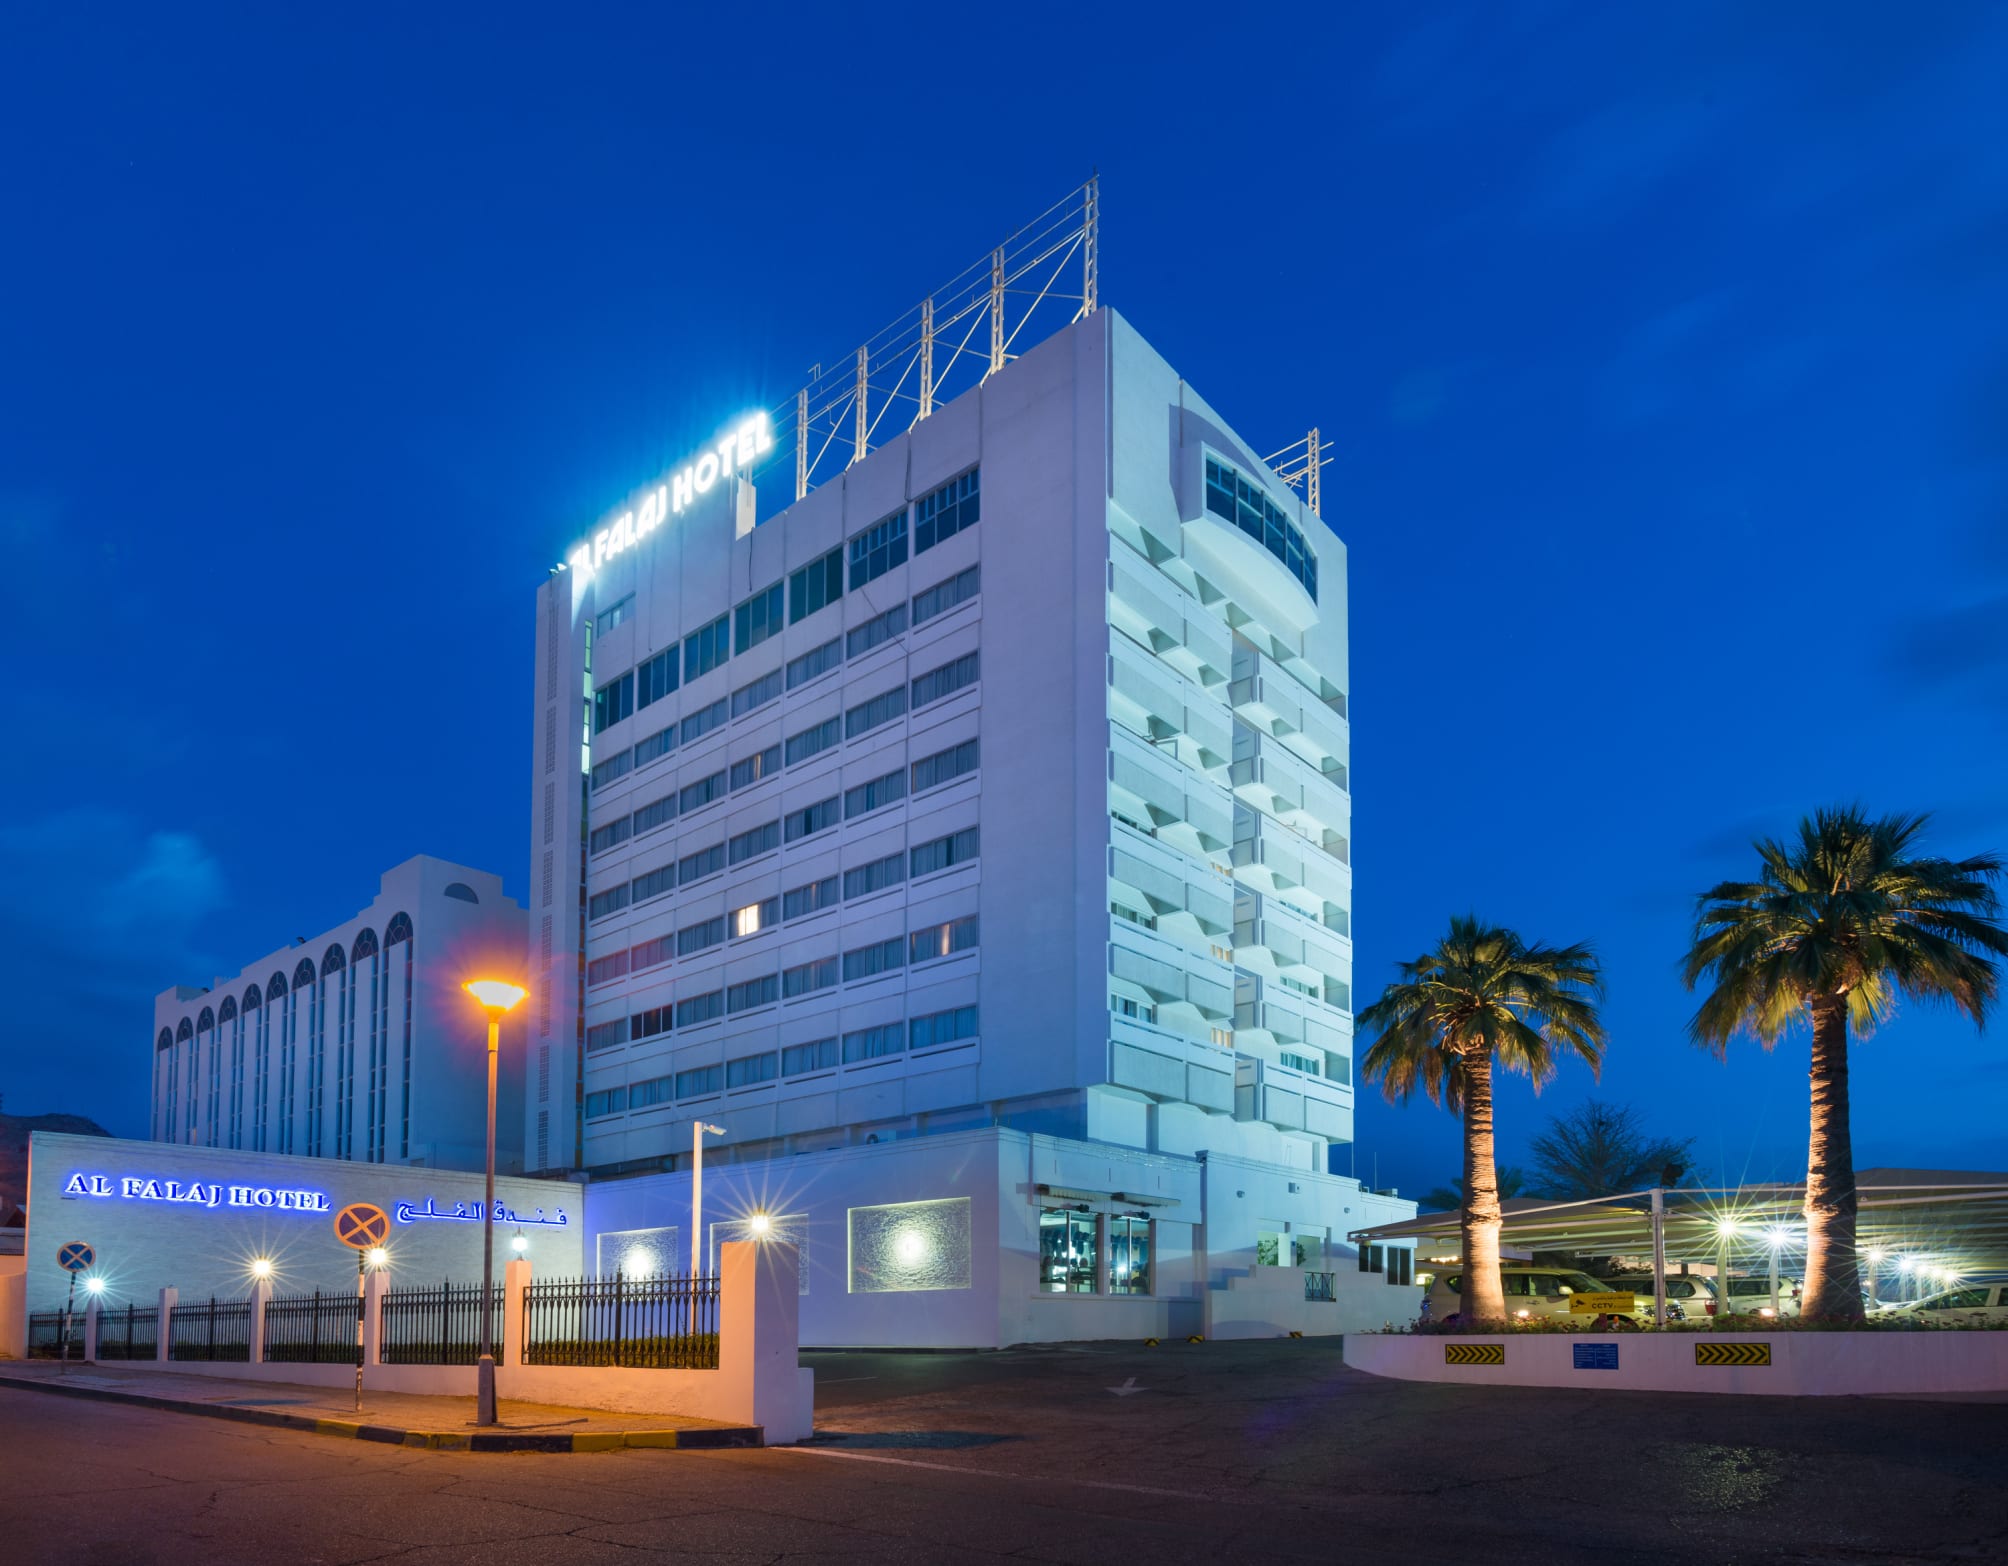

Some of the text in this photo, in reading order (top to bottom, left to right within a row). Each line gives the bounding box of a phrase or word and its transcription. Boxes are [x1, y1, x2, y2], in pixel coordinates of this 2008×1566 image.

[593, 485, 667, 568] FALAJ
[672, 411, 772, 513] HOTEL
[65, 1173, 332, 1212] AL FALAJ HOTEL
[397, 1197, 568, 1226] فندق الفلج
